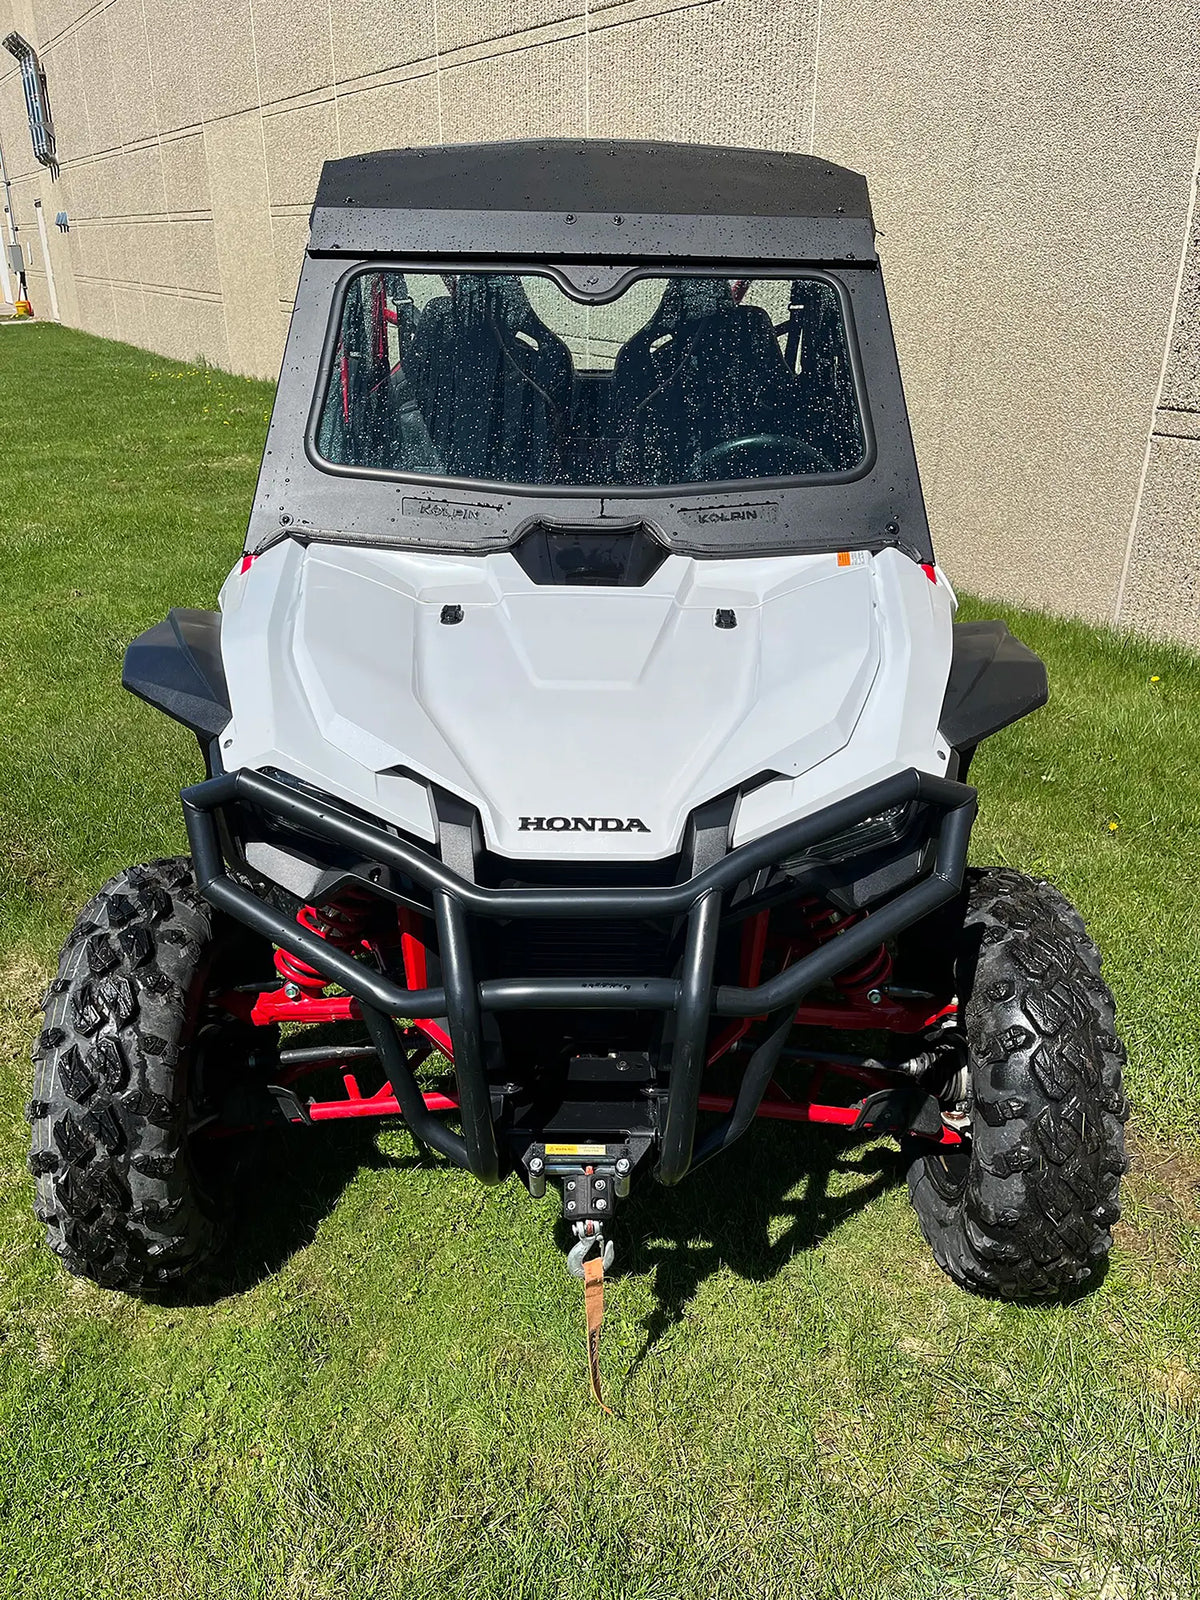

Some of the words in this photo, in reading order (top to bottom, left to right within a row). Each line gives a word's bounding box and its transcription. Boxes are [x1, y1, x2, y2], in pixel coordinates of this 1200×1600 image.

[419, 503, 480, 520] KOLPIN
[698, 510, 758, 524] KOLPIN
[517, 816, 652, 833] HONDA
